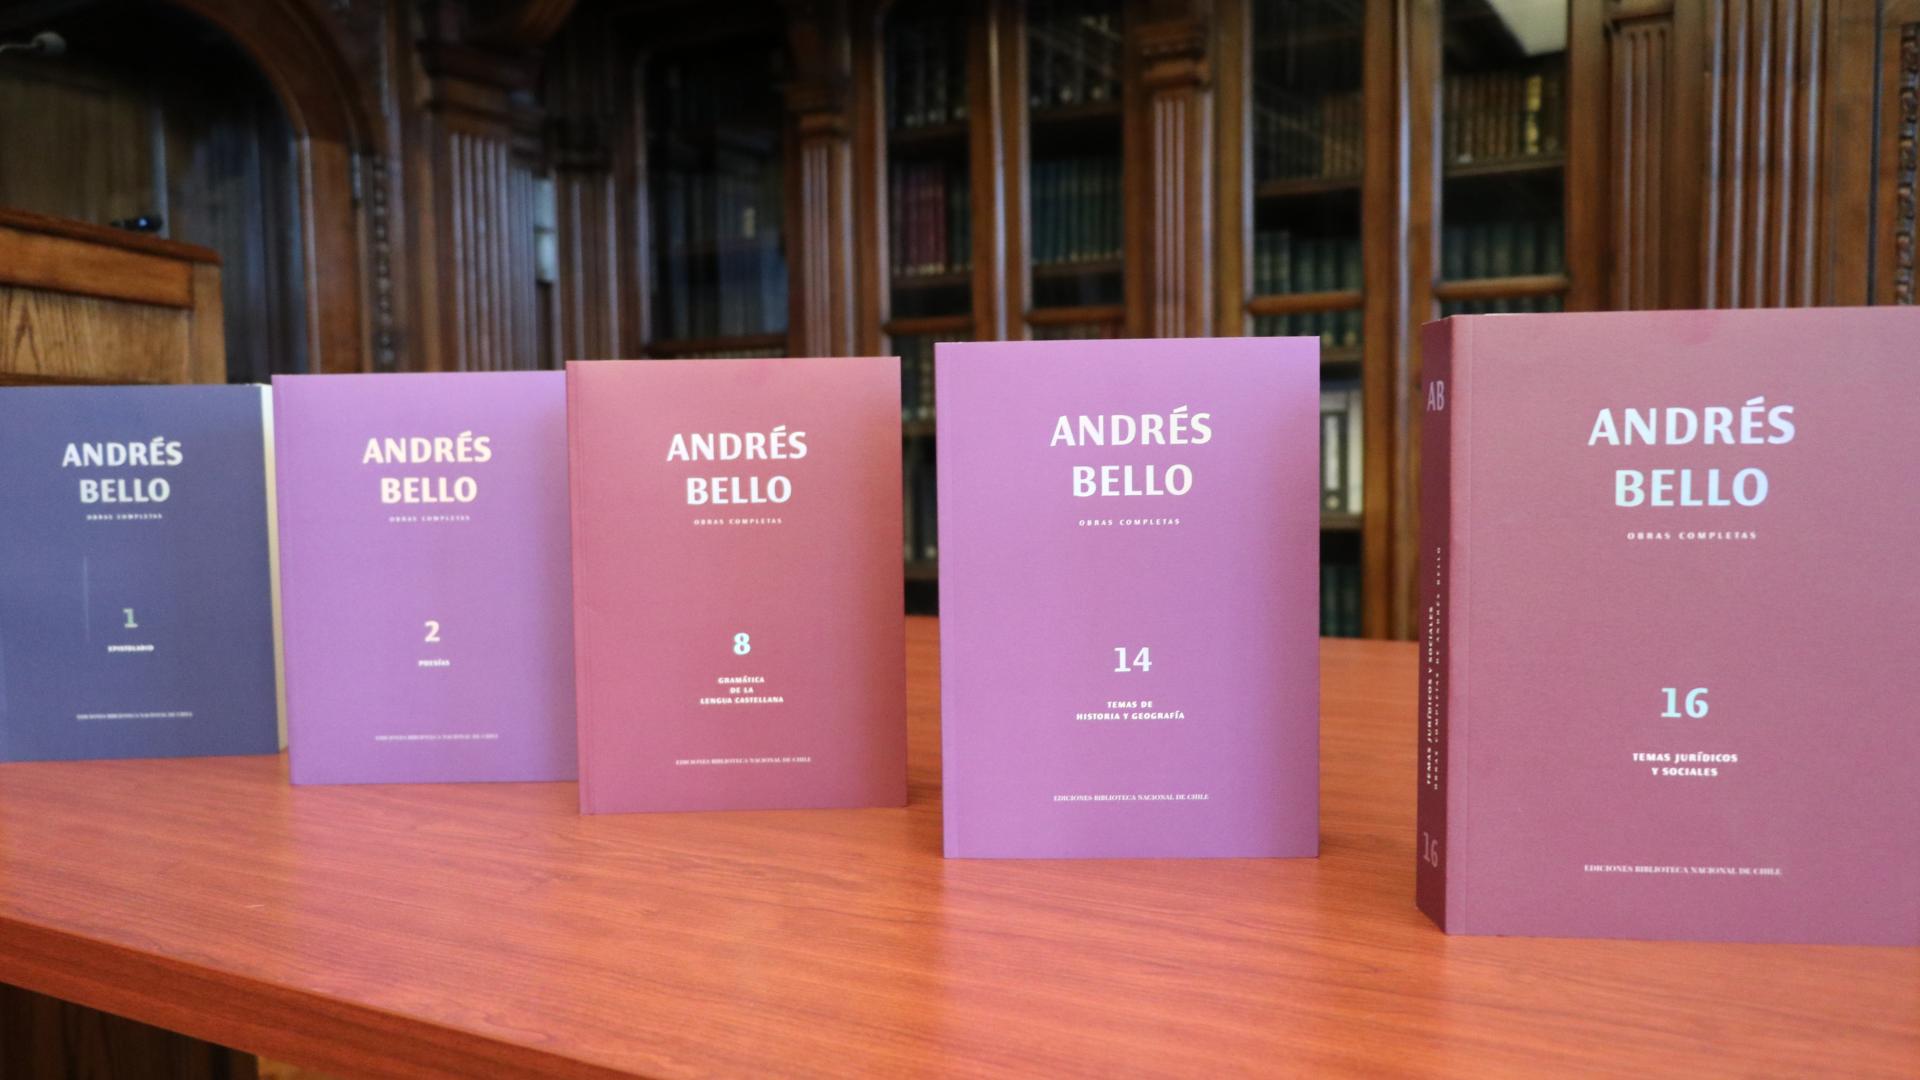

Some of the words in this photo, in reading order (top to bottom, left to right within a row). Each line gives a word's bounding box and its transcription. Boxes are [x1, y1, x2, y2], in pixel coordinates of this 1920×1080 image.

[1426, 380, 1445, 412] AB
[1050, 405, 1212, 446] ANDRÉS
[1588, 396, 1795, 446] ANDRÉS
[62, 436, 183, 467] ANDRÉS
[363, 430, 491, 464] ANDRÉS
[667, 425, 807, 461] ANDRÉS
[80, 478, 170, 503] BELLO
[381, 476, 477, 504] BELLO
[687, 476, 791, 505] BELLO
[1073, 464, 1192, 497] BELLO
[1615, 468, 1768, 507] BELLO
[694, 518, 724, 526] OBRAS
[729, 517, 781, 525] COMPLETAS
[1079, 519, 1112, 527] OBRAS
[1120, 518, 1179, 526] COMPLETAS
[1627, 531, 1670, 540] OBRAS
[1679, 531, 1756, 540] COMPLETAS
[123, 608, 138, 628] 1
[425, 621, 440, 642] 2
[733, 633, 751, 655] 8
[1114, 647, 1152, 672] 14
[718, 675, 764, 685] GRAMÁTICA
[730, 686, 740, 695] DE
[743, 686, 753, 694] LA
[700, 696, 732, 705] LENGUA
[734, 696, 784, 704] CASTELLANA
[1108, 700, 1137, 709] TEMAS
[1141, 700, 1152, 709] DE
[1661, 688, 1708, 718] 16
[1076, 712, 1120, 721] HISTORIA
[1122, 712, 1129, 721] Y
[1132, 710, 1184, 721] GEOGRAFÍA
[1633, 752, 1670, 762] TEMAS
[1675, 751, 1738, 764] JURÍDICOS
[1651, 767, 1659, 776] Y
[1662, 766, 1718, 777] SOCIALES
[1584, 864, 1633, 873] EDICIONES
[1635, 865, 1688, 874] BIBLIOTECA
[1691, 866, 1737, 876] NACIONAL
[1739, 867, 1751, 876] DE
[1753, 867, 1781, 876] CHILE
